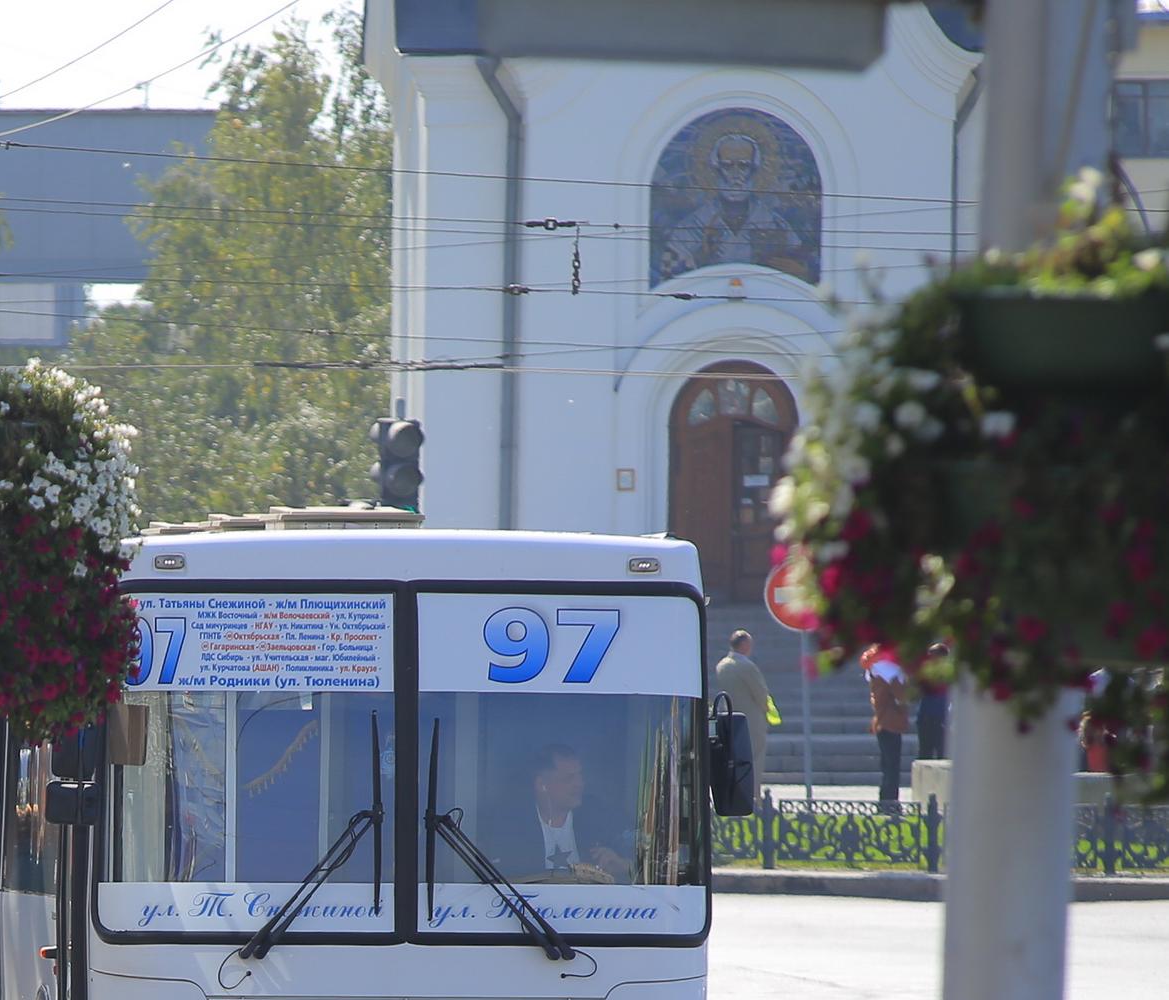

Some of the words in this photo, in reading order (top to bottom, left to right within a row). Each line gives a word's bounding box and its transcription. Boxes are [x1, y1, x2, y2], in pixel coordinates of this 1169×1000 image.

[140, 600, 156, 611] ул.
[158, 599, 205, 609] Татьяны
[208, 598, 266, 610] Снежиной
[276, 599, 297, 610] ж/м
[300, 598, 386, 610] Плющихинский
[197, 612, 217, 620] МЖК
[218, 611, 258, 620] Восточный
[279, 611, 330, 620] Волочаевский
[336, 613, 347, 622] ул.
[348, 612, 379, 621] Куприна
[191, 622, 204, 631] Сад
[254, 622, 273, 630] НГАУ
[279, 624, 289, 632] ул.
[290, 622, 324, 630] Никитина
[342, 622, 386, 632] Октябрьский
[199, 632, 222, 640] ГПНТБ
[233, 632, 280, 642] Октябрьская
[285, 632, 297, 640] Пл.
[298, 632, 325, 640] Ленина
[330, 632, 343, 642] Кр.
[344, 632, 378, 642] Проспект
[210, 642, 255, 652] Гагаринская
[322, 643, 337, 652] Гор.
[338, 643, 373, 652] Больница
[483, 606, 620, 684] 97
[216, 653, 243, 663] Сибирь
[251, 654, 262, 663] ул.
[263, 653, 309, 662] Учительская
[332, 652, 376, 662] Юбилейный
[200, 665, 210, 673] ул.
[212, 664, 251, 673] Курчатова
[252, 663, 280, 673] (АШАН)
[285, 664, 334, 672] Поликлиника
[339, 665, 350, 673] ул.
[352, 664, 378, 673] Краузе
[178, 676, 206, 687] ж/м
[210, 675, 270, 688] Родники
[274, 675, 300, 688] (ул.
[304, 675, 380, 688] Тюленина)
[138, 902, 179, 927] ул.
[188, 892, 233, 917] Т.
[244, 892, 383, 918] Снжиной
[429, 903, 476, 928] ул.
